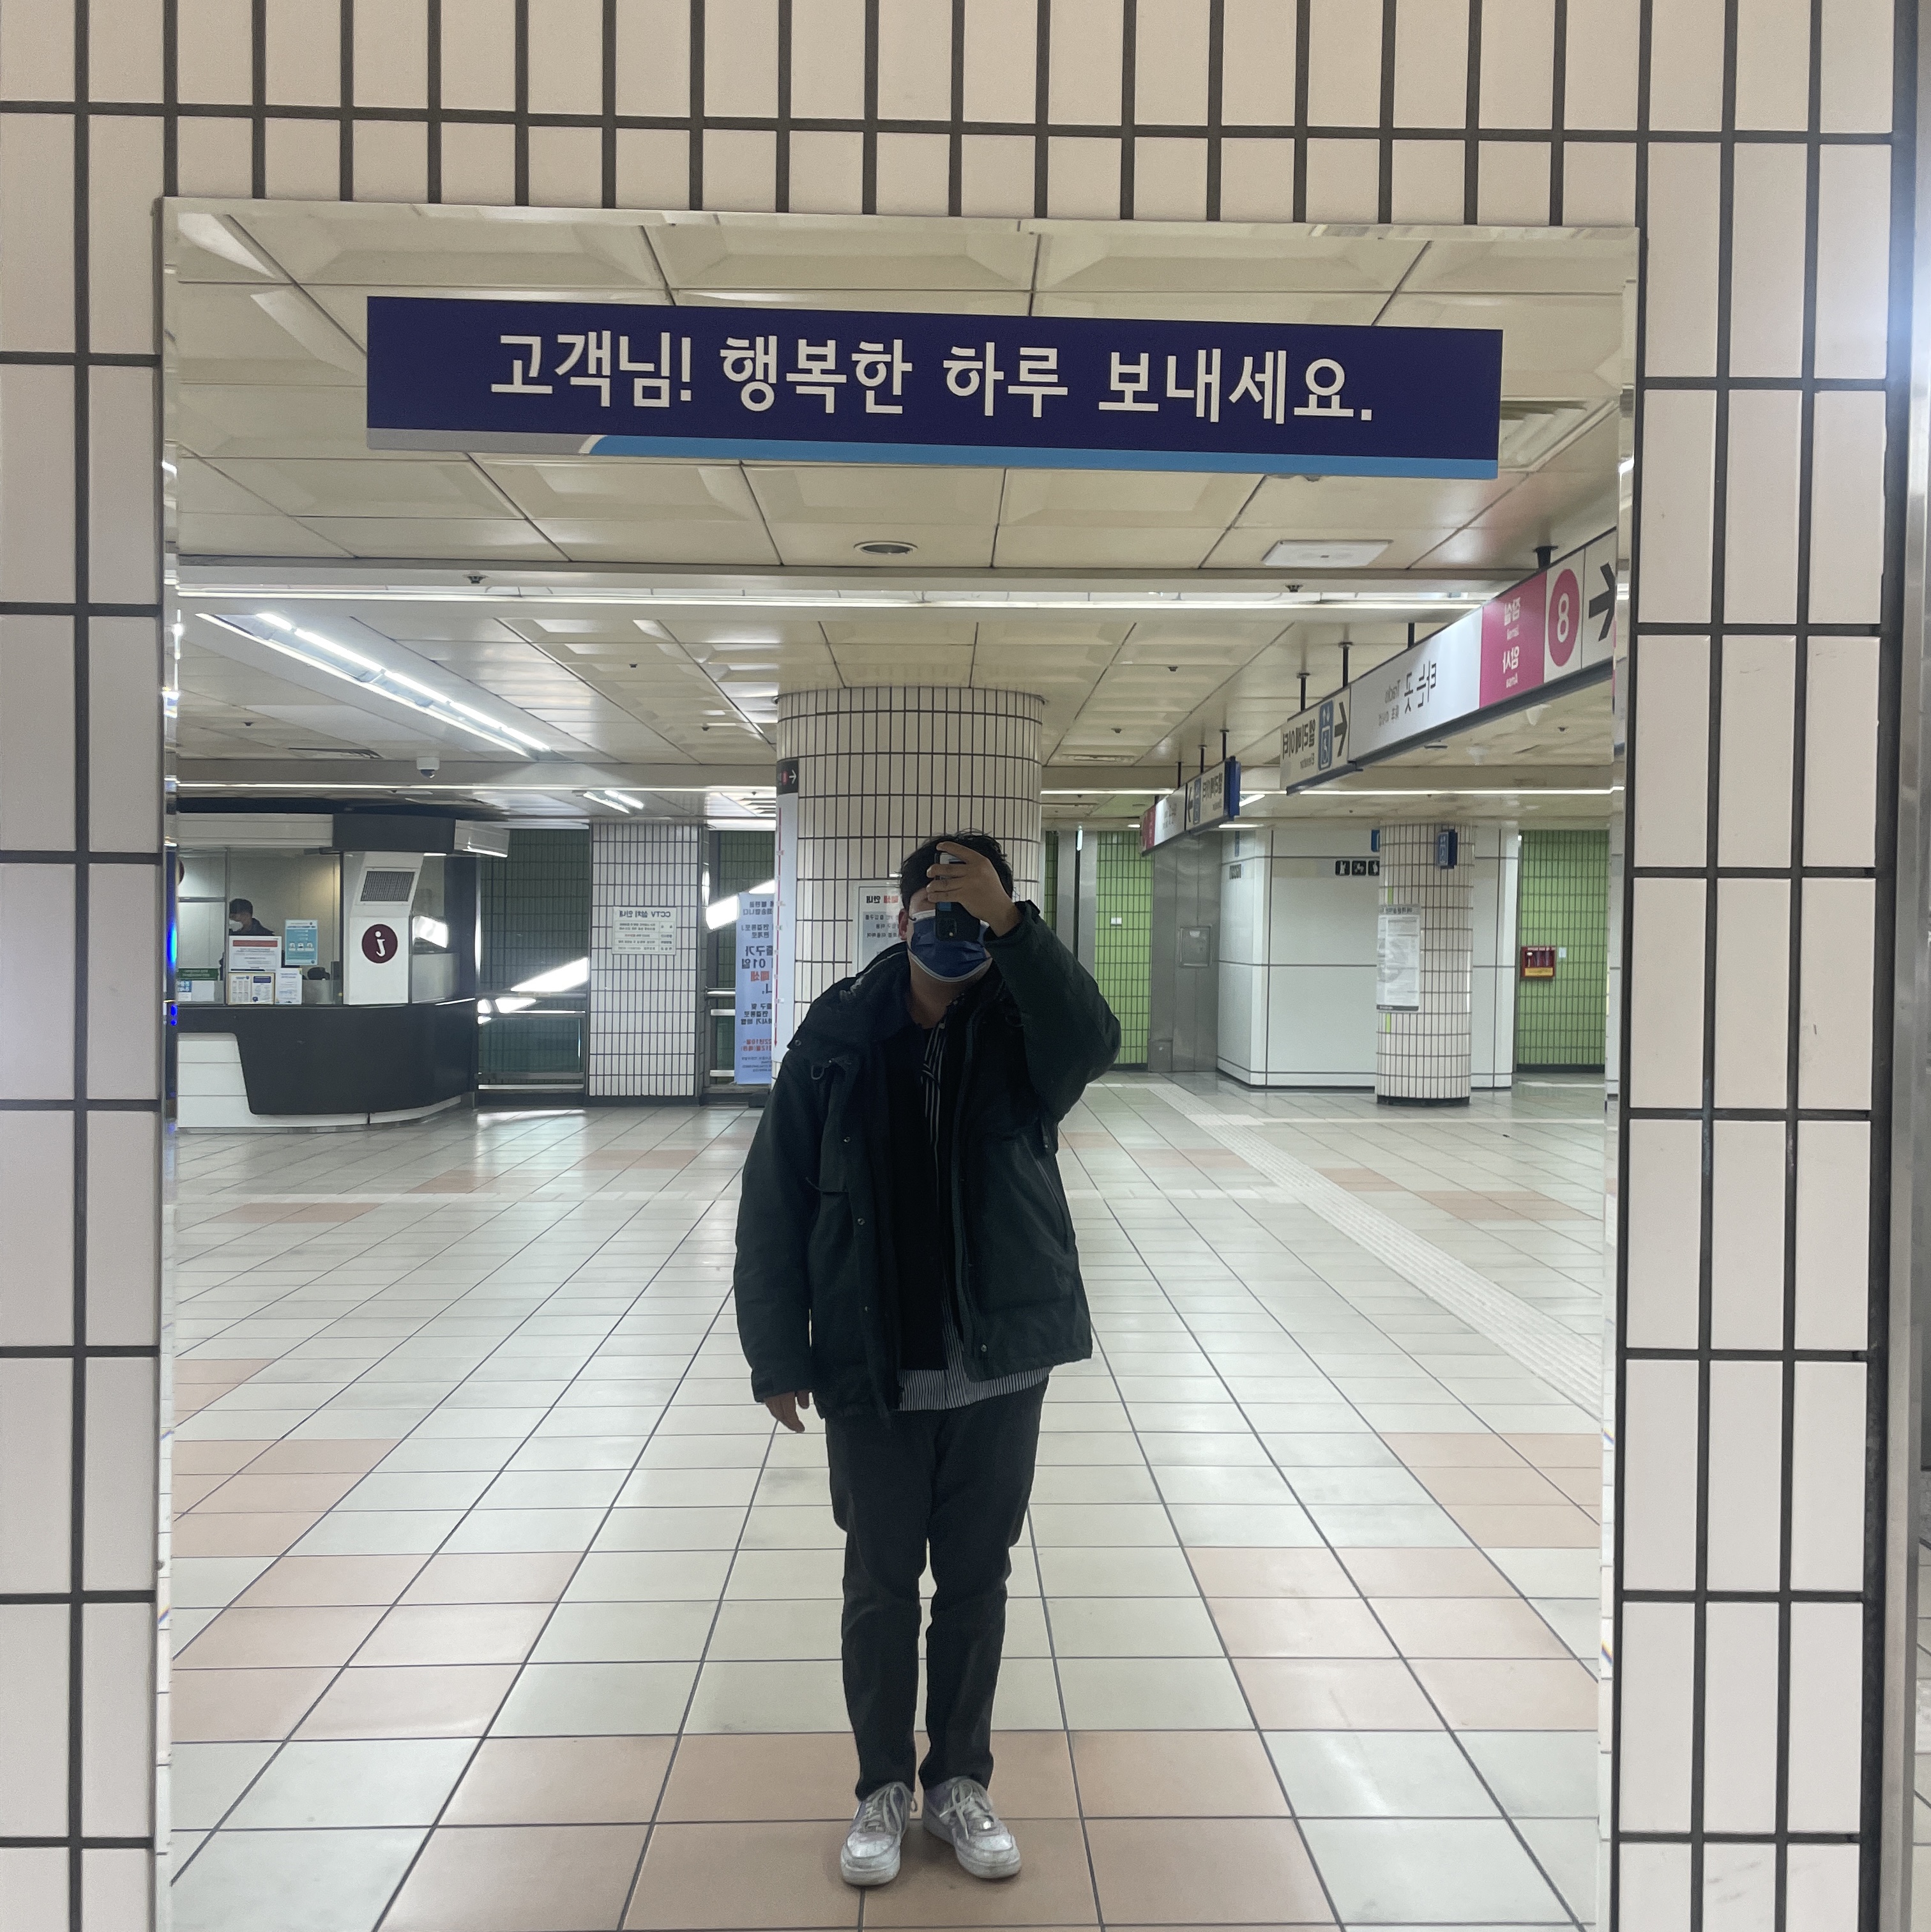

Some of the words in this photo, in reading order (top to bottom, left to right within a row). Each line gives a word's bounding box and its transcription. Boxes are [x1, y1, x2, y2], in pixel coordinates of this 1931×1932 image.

[491, 330, 692, 407] 고객님!
[720, 335, 912, 414] 행복한
[943, 342, 1068, 418] 하루
[1098, 348, 1372, 425] 보내세요.
